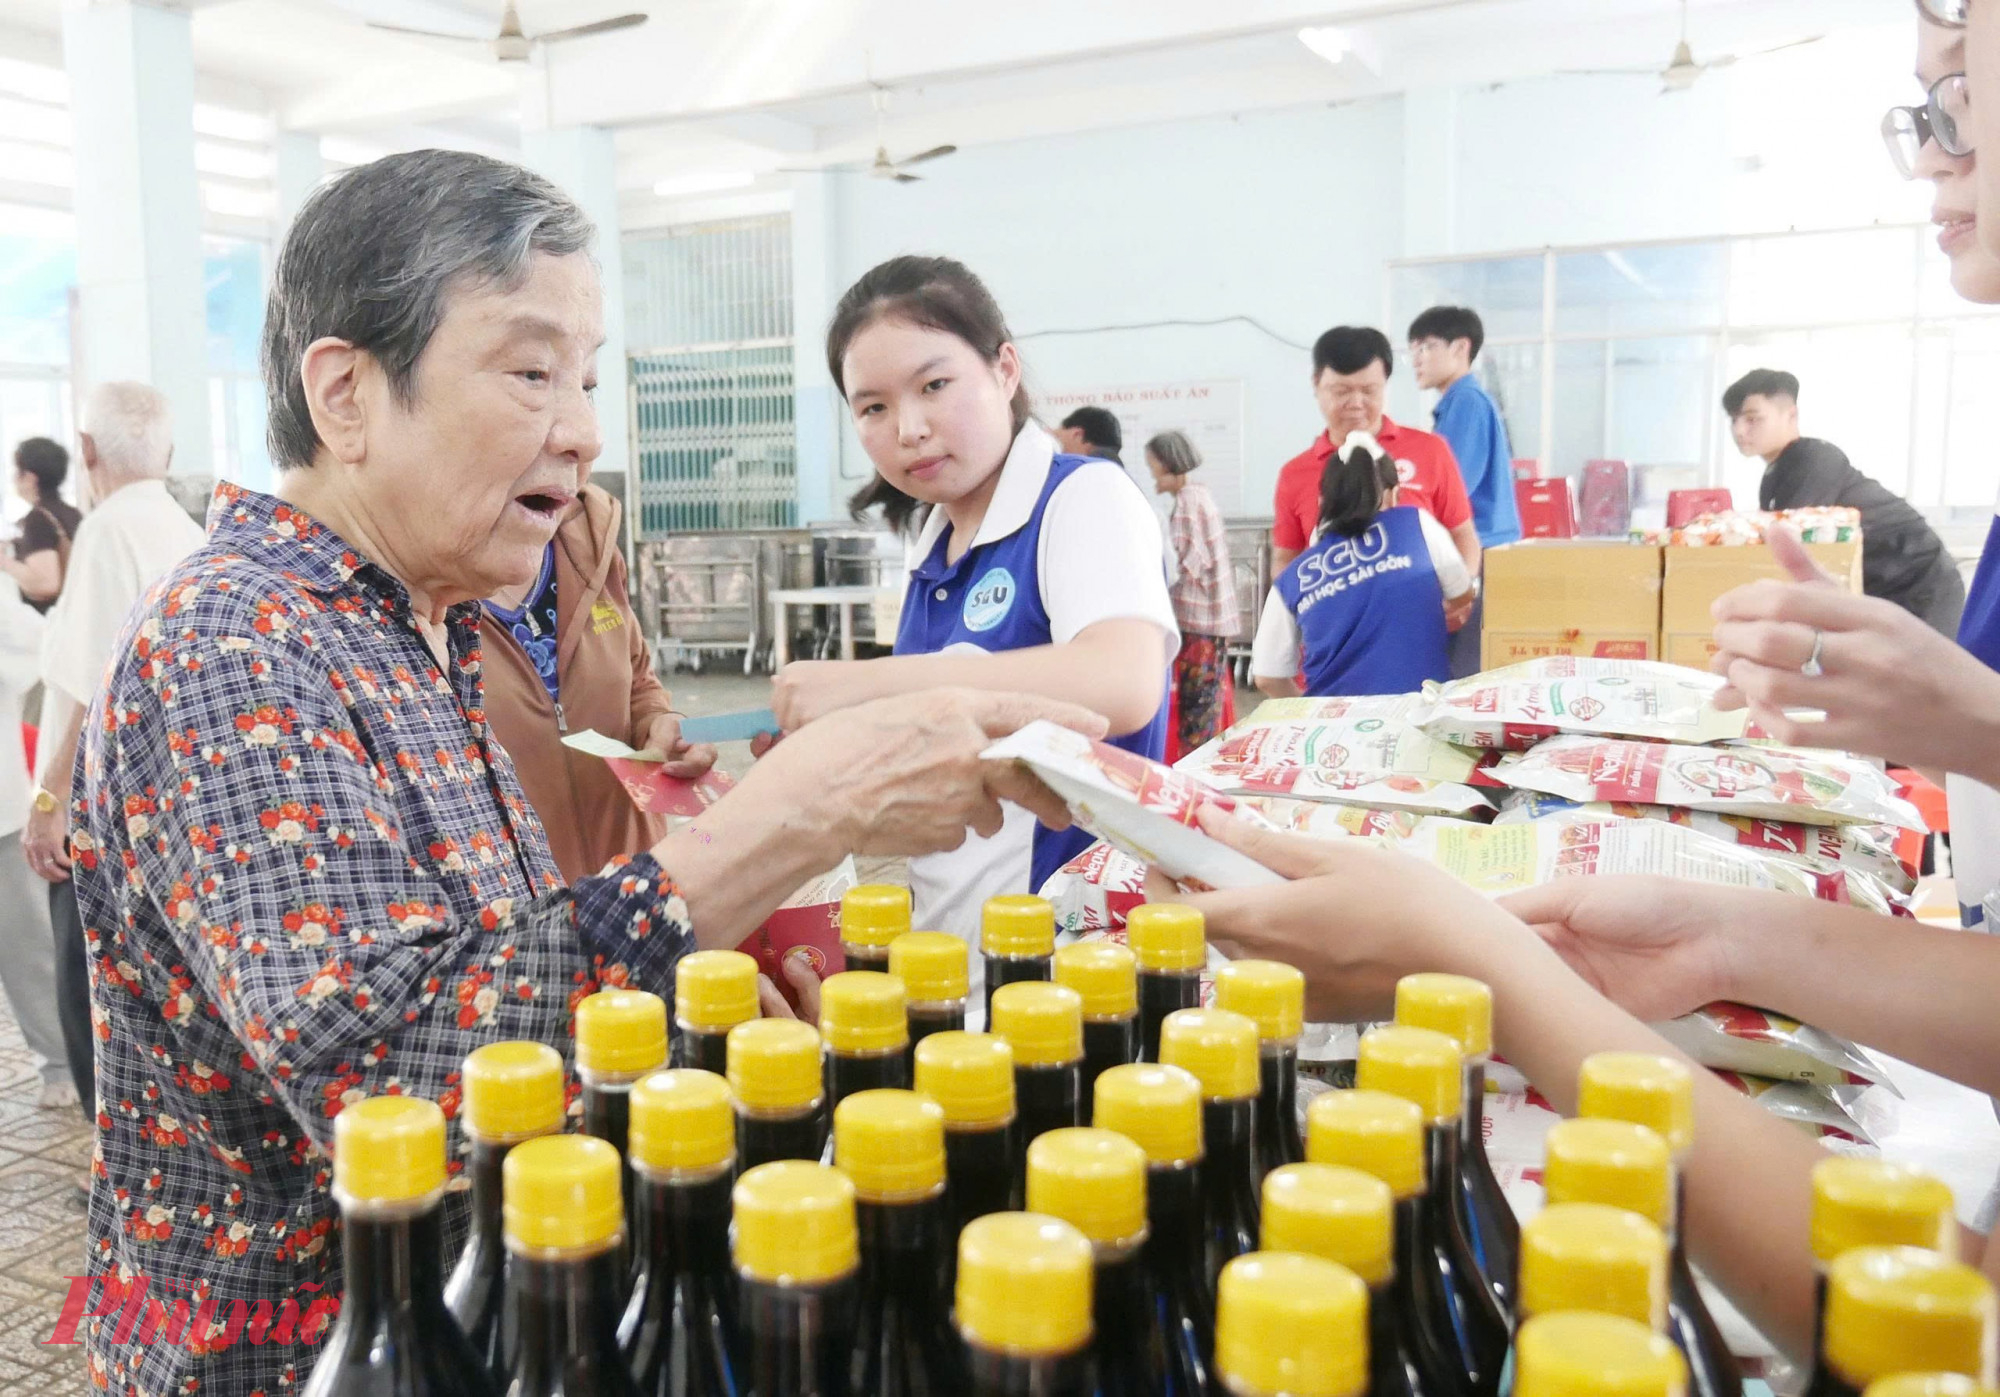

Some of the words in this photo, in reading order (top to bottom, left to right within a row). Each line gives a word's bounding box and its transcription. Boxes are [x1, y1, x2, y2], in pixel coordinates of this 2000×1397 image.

[1297, 522, 1388, 592] SGU
[1315, 578, 1346, 600] HỌC
[1348, 567, 1374, 585] SÀI
[1375, 554, 1411, 573] GÒN
[971, 586, 1007, 608] SGU
